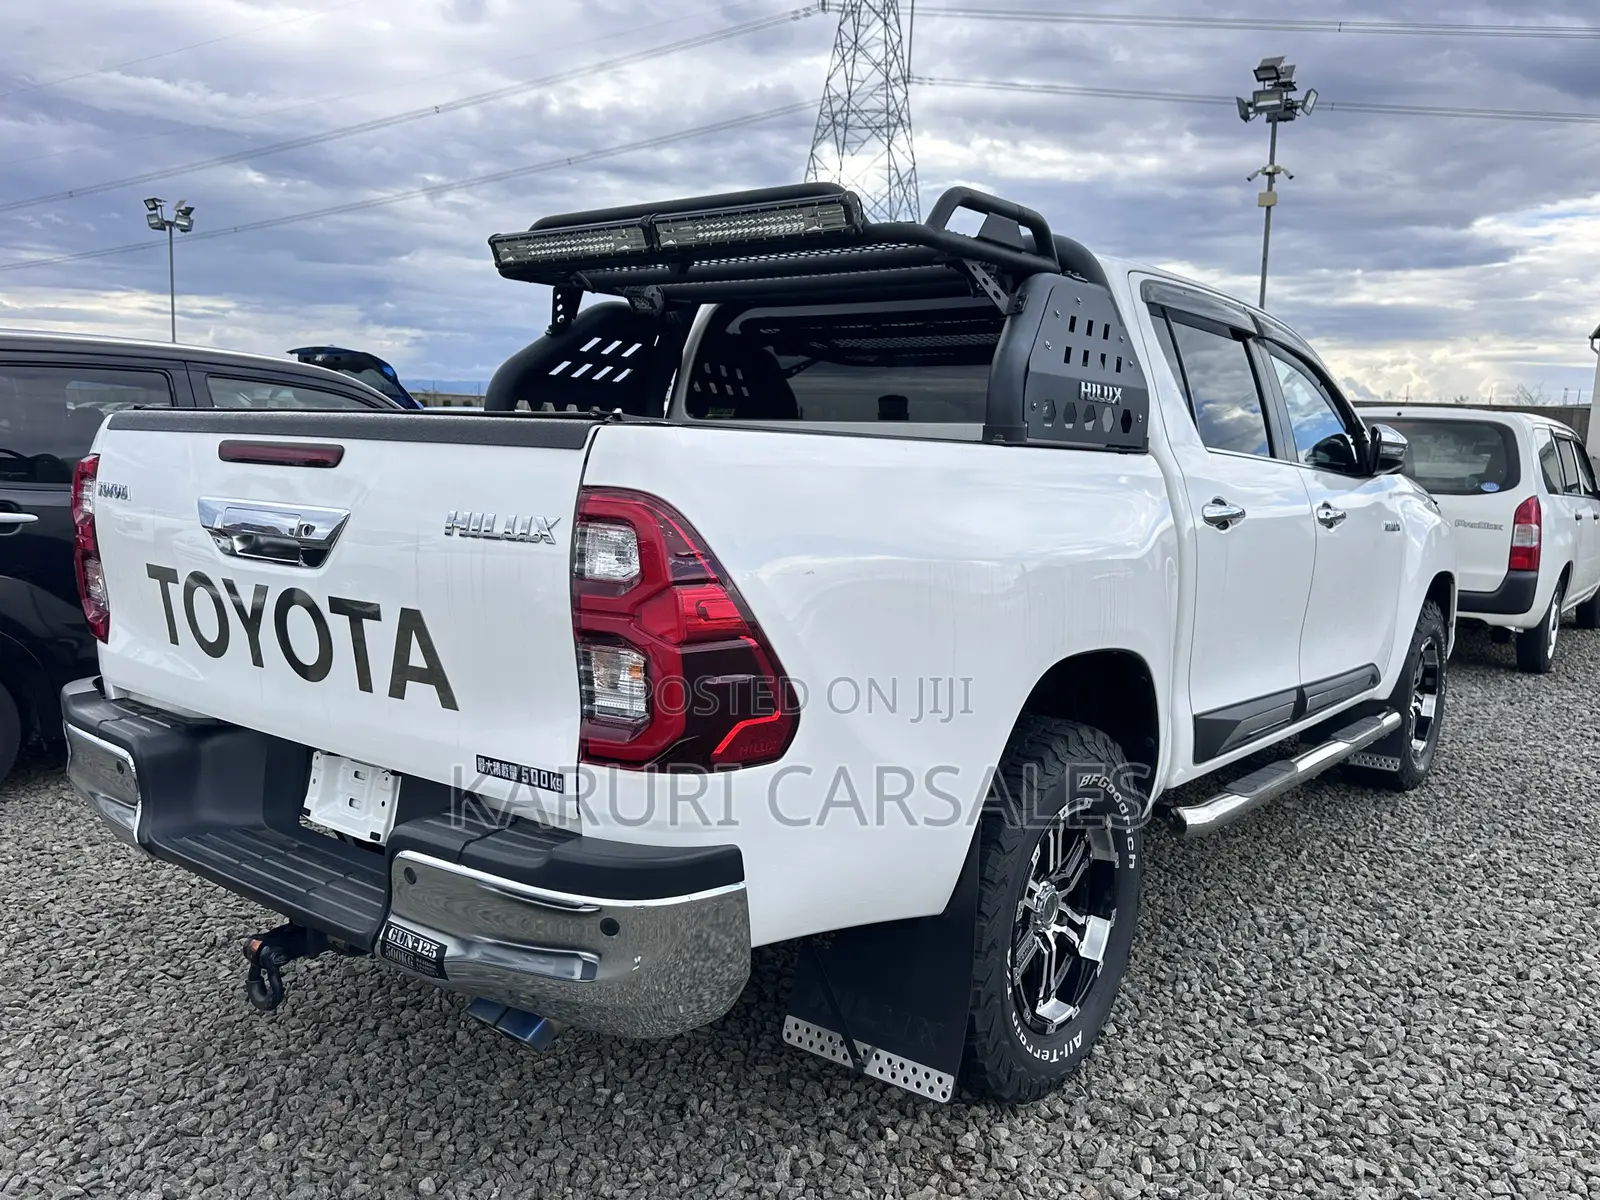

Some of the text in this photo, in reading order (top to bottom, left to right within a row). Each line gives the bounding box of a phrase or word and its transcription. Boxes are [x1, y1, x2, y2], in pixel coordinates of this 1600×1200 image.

[1080, 381, 1122, 405] HILUX
[97, 481, 132, 502] TOYOTA
[444, 510, 561, 546] HILUX
[146, 563, 460, 712] TOYOTA
[477, 756, 563, 793] 最大積載量 500kg
[385, 944, 414, 968] 500KG
[388, 927, 438, 959] GUN-125
